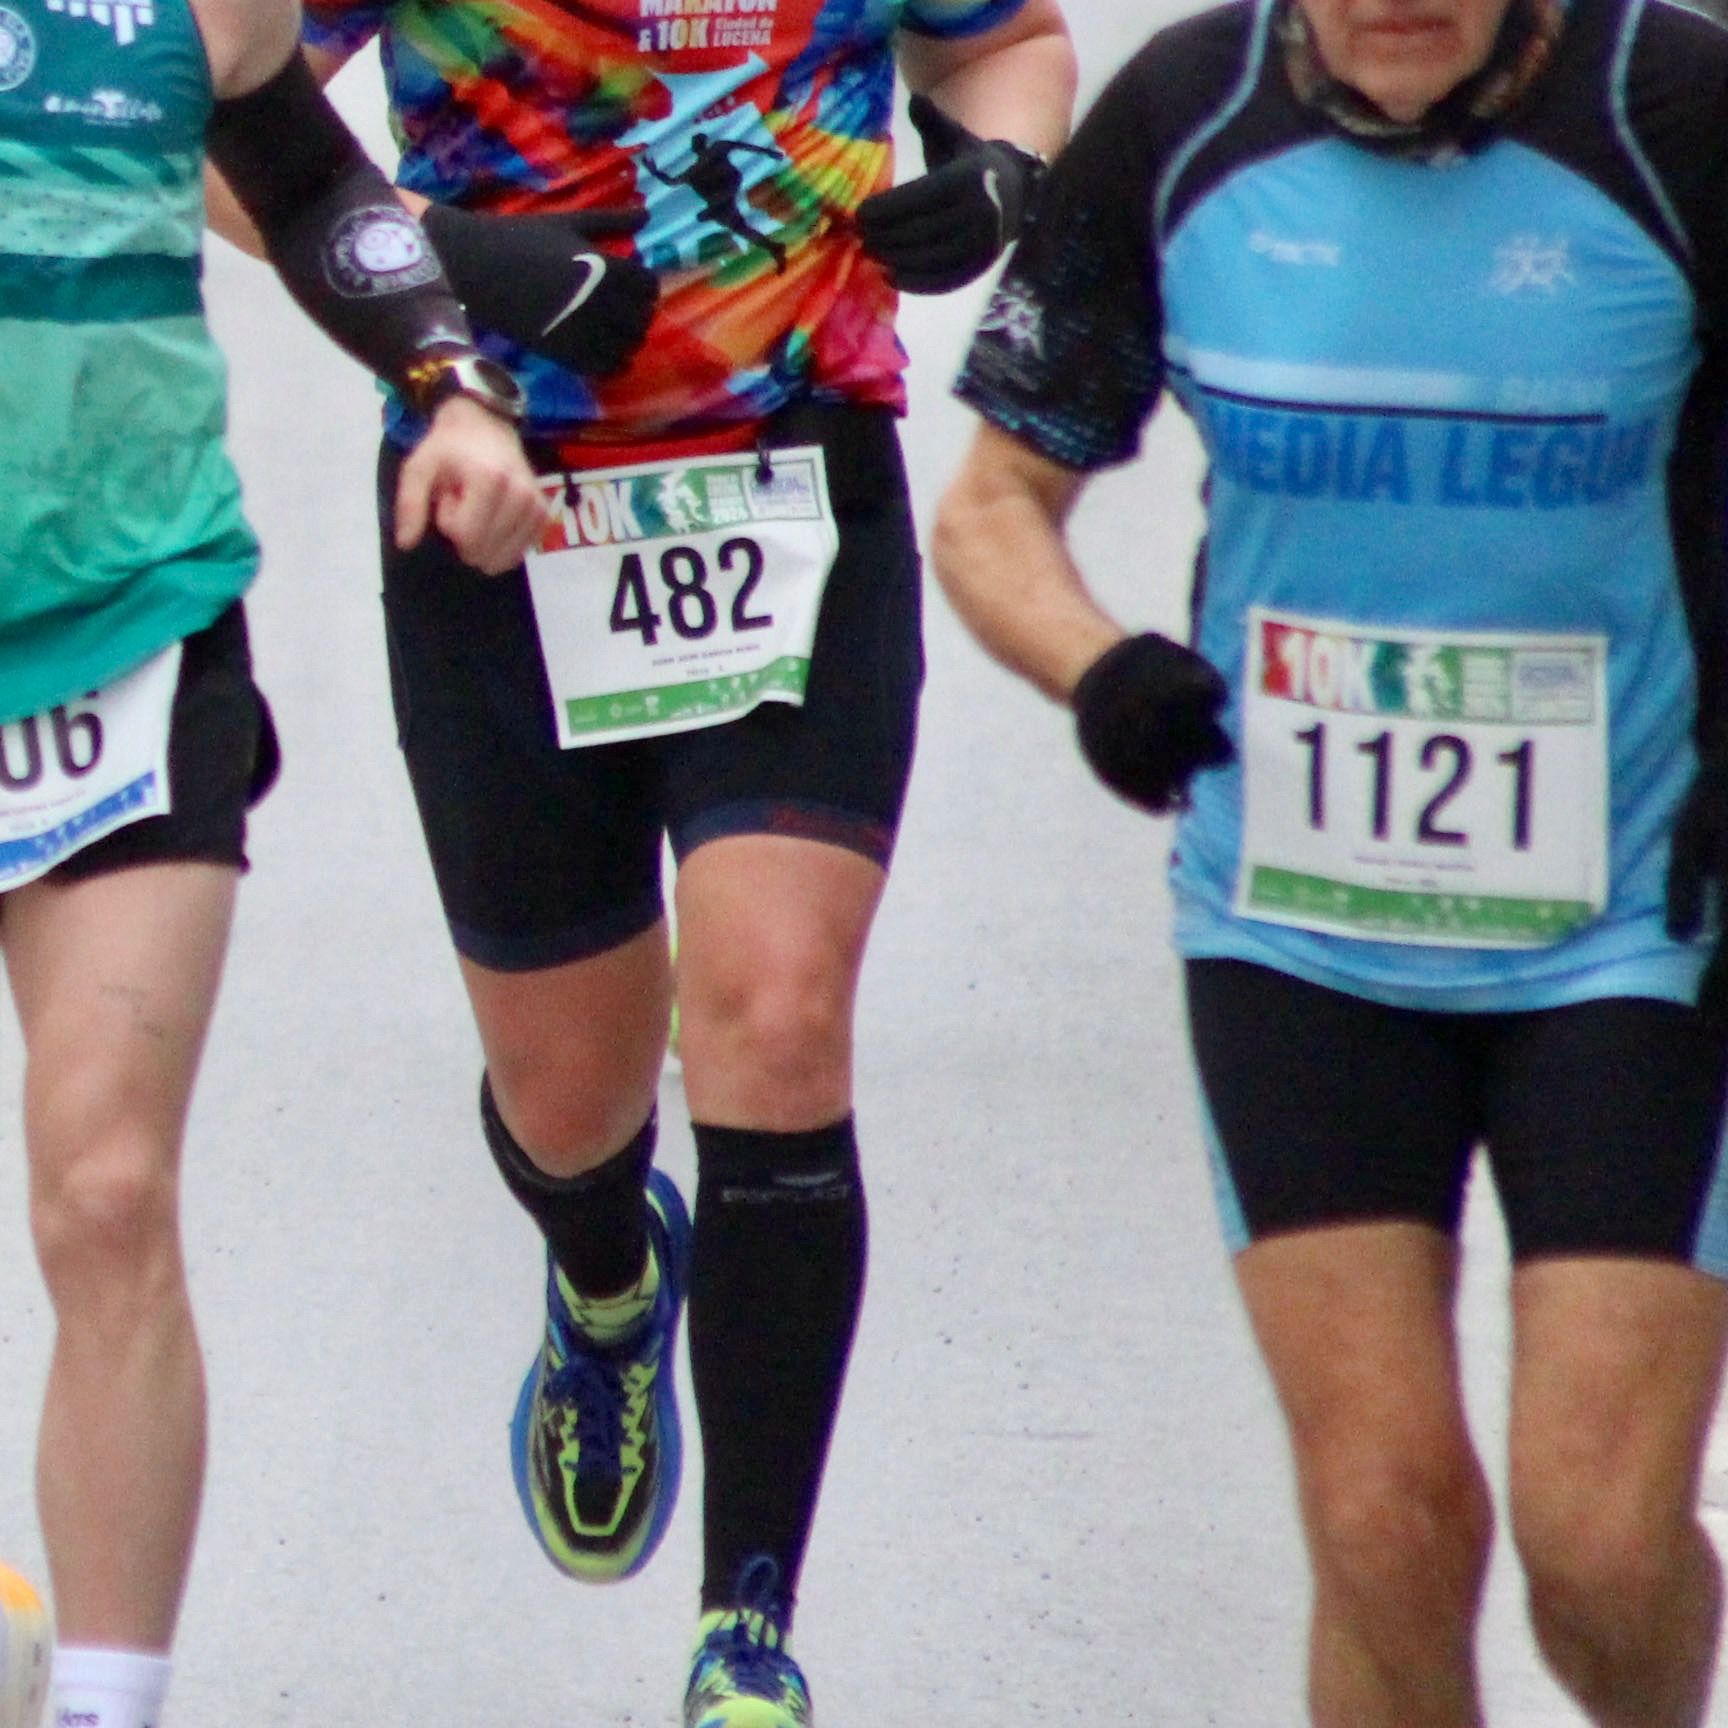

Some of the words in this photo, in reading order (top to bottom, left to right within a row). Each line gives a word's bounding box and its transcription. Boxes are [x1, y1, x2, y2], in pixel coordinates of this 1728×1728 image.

[656, 17, 709, 50] 10K
[608, 536, 774, 647] 482
[1294, 721, 1536, 852] 1121
